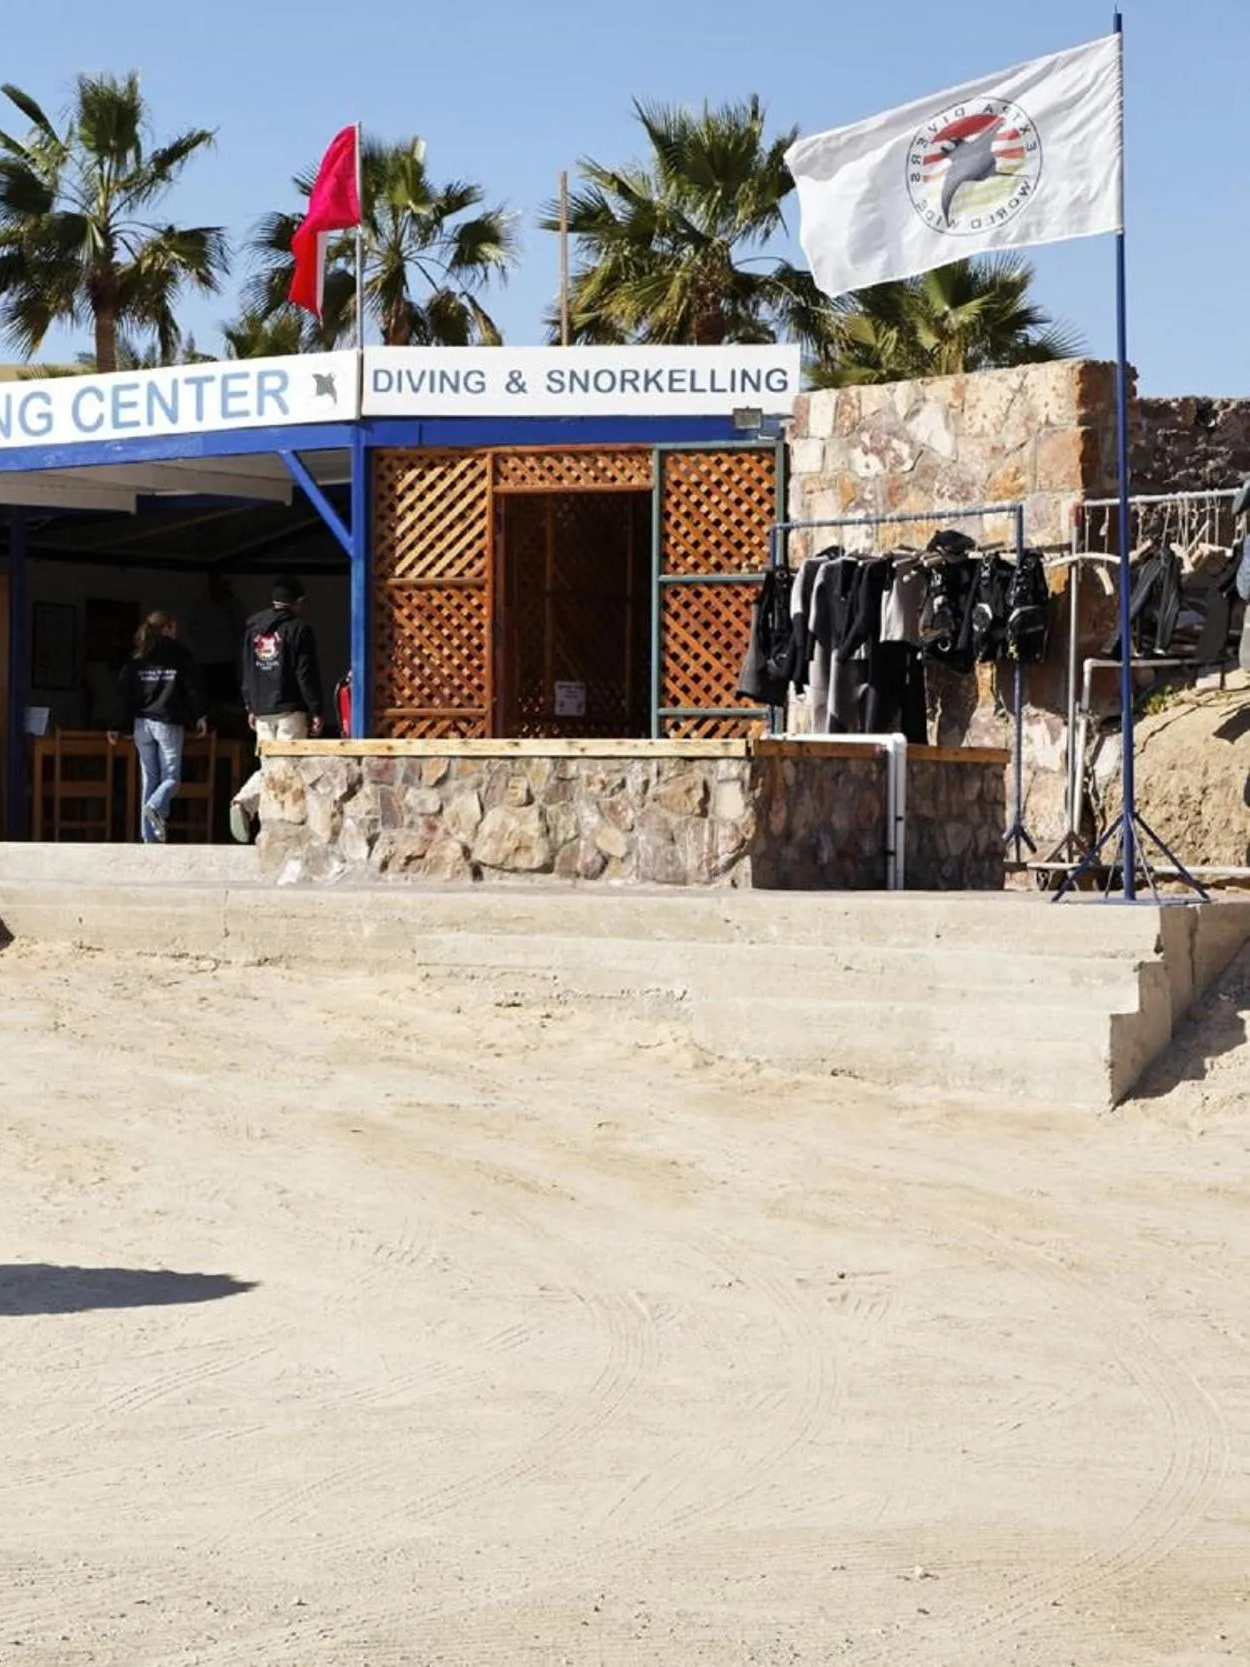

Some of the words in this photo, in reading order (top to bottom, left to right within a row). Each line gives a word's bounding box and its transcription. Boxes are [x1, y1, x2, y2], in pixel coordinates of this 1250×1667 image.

[71, 369, 290, 432] CENTER
[372, 368, 487, 394] DIVING
[505, 370, 528, 393] &
[545, 367, 789, 393] SNORKELLING
